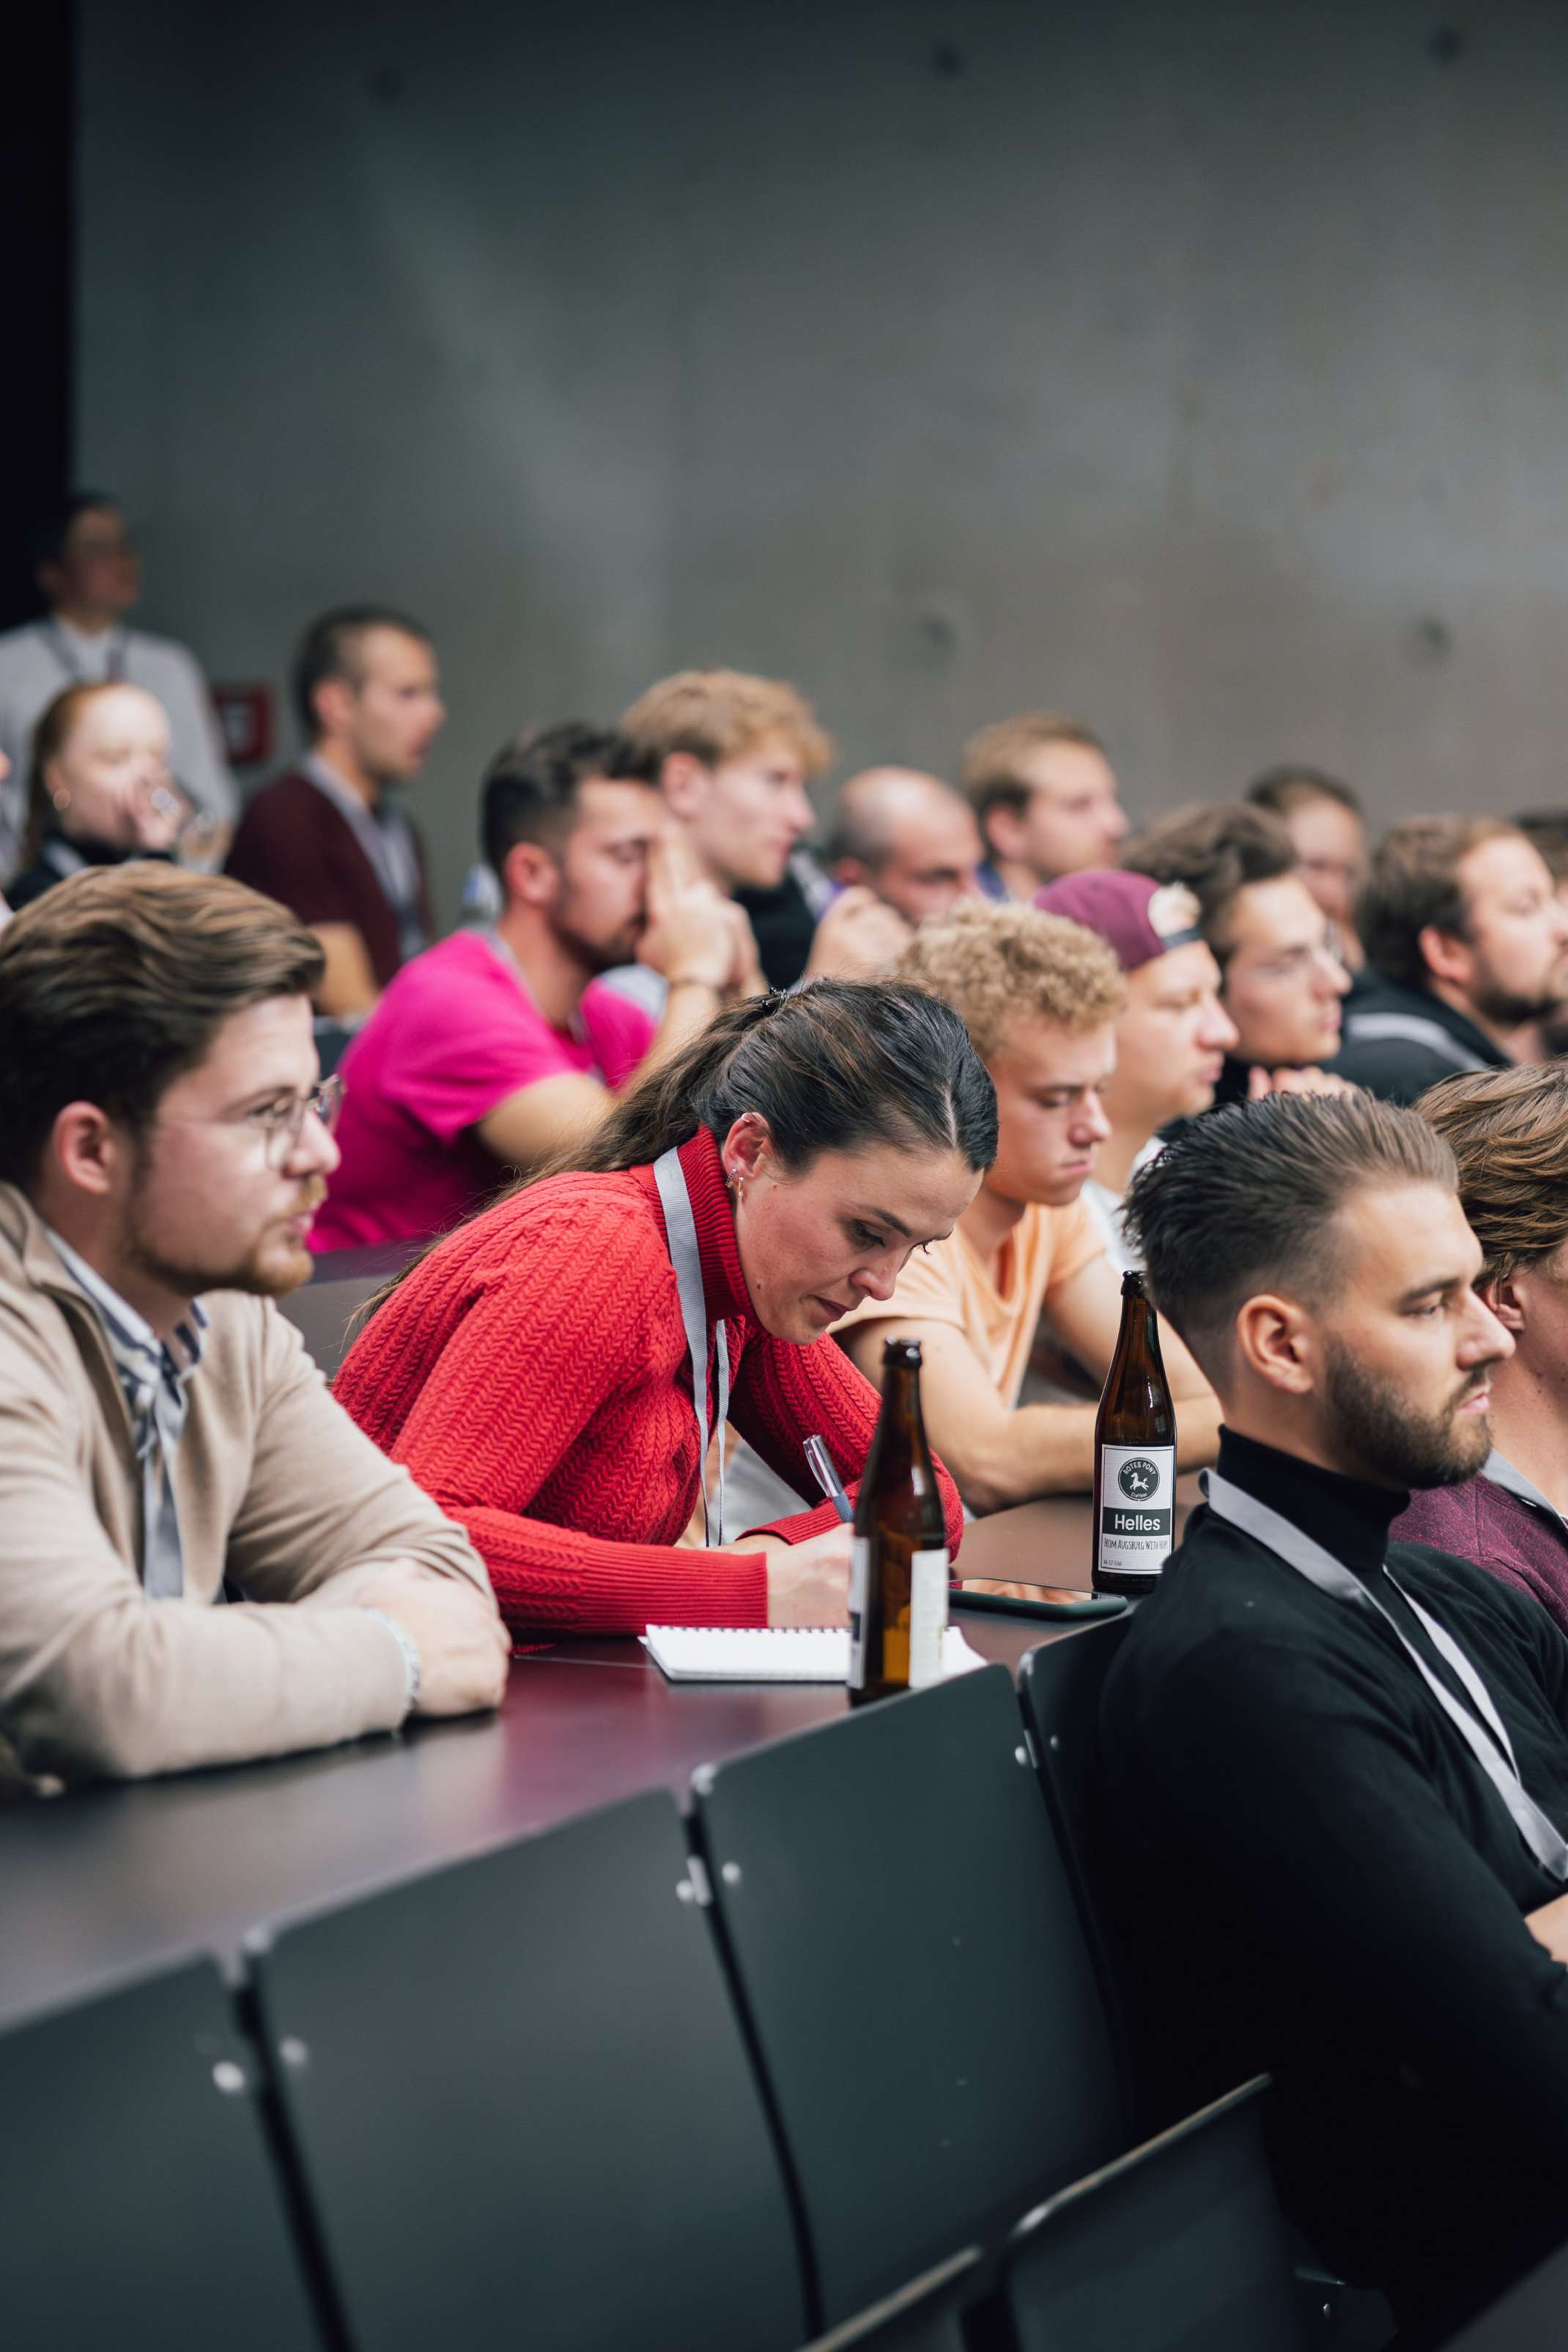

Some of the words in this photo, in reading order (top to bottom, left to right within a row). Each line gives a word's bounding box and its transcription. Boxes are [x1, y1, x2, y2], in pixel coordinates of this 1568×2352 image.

[1123, 1461, 1142, 1475] ROTES
[1142, 1462, 1156, 1475] PONY
[1114, 1513, 1161, 1531] Helles
